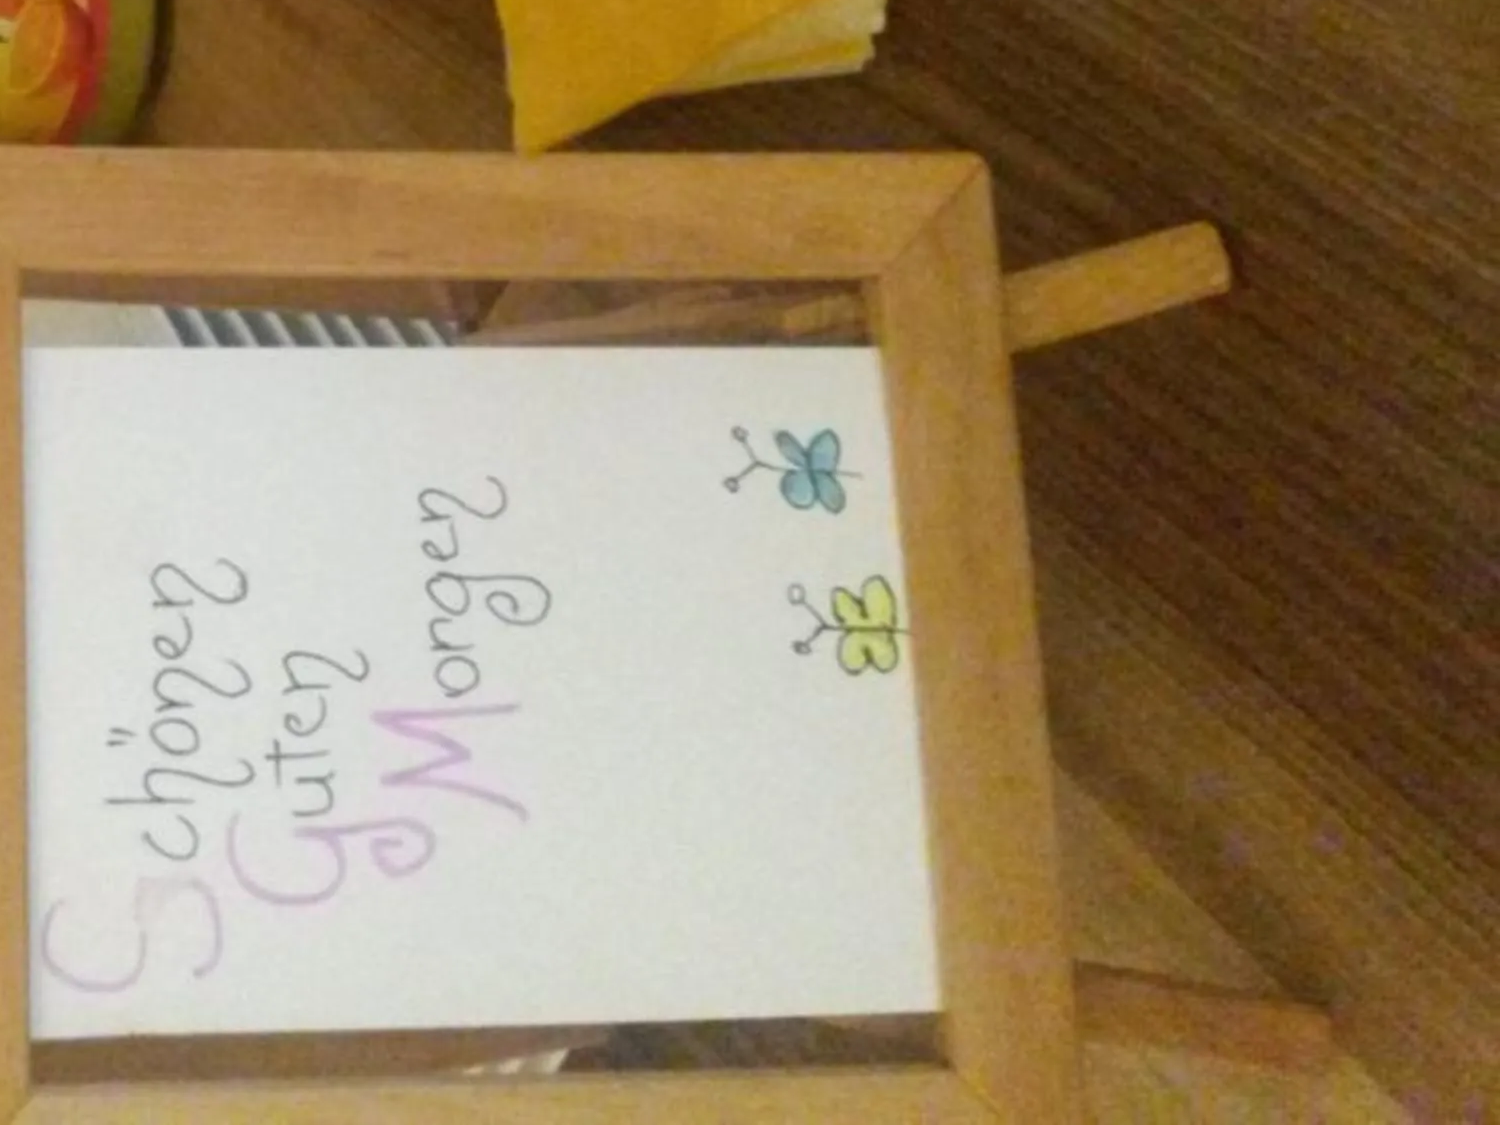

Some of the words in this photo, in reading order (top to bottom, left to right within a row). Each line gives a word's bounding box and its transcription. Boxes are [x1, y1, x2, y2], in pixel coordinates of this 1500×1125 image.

[39, 557, 256, 994] Schönen
[225, 649, 436, 908] Guten
[370, 475, 552, 822] Morgen
